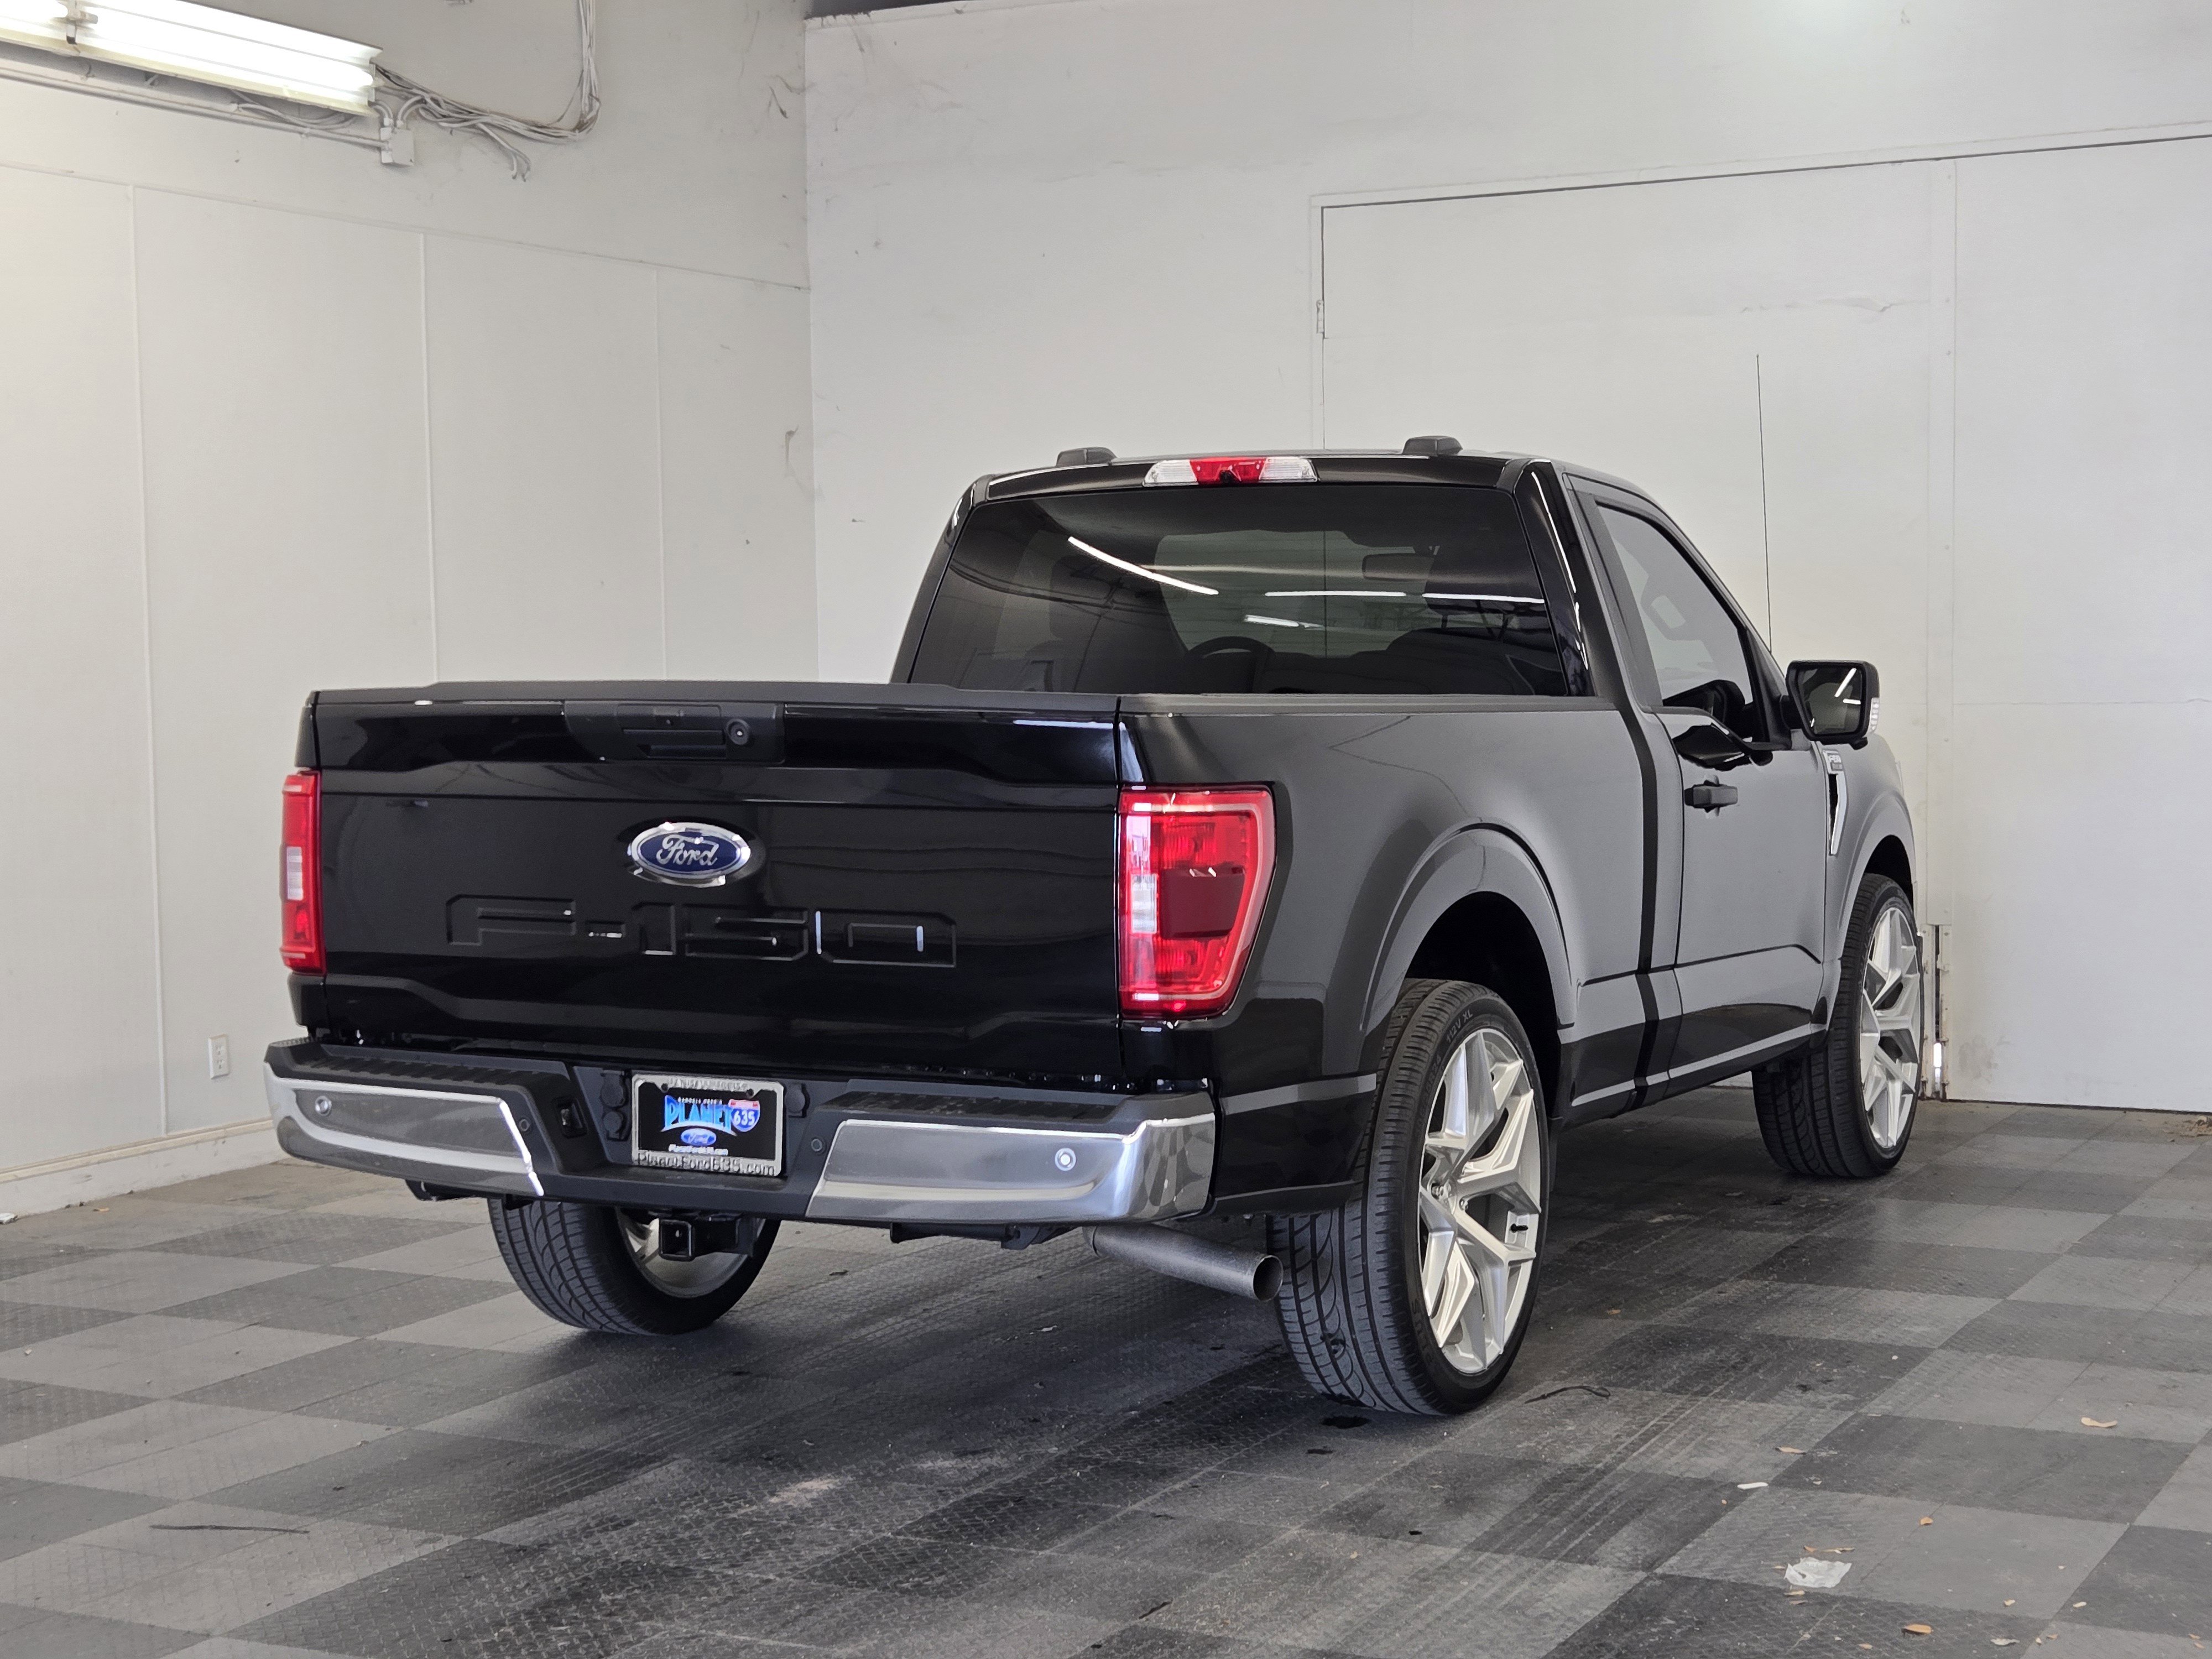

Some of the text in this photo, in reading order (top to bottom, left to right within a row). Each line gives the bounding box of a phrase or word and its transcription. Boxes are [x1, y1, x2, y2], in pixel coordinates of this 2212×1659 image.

[656, 834, 719, 865] Ford
[446, 894, 957, 967] F-150
[1446, 1009, 1473, 1043] 112V XL
[665, 1095, 733, 1132] PLANET
[733, 1110, 755, 1126] 635
